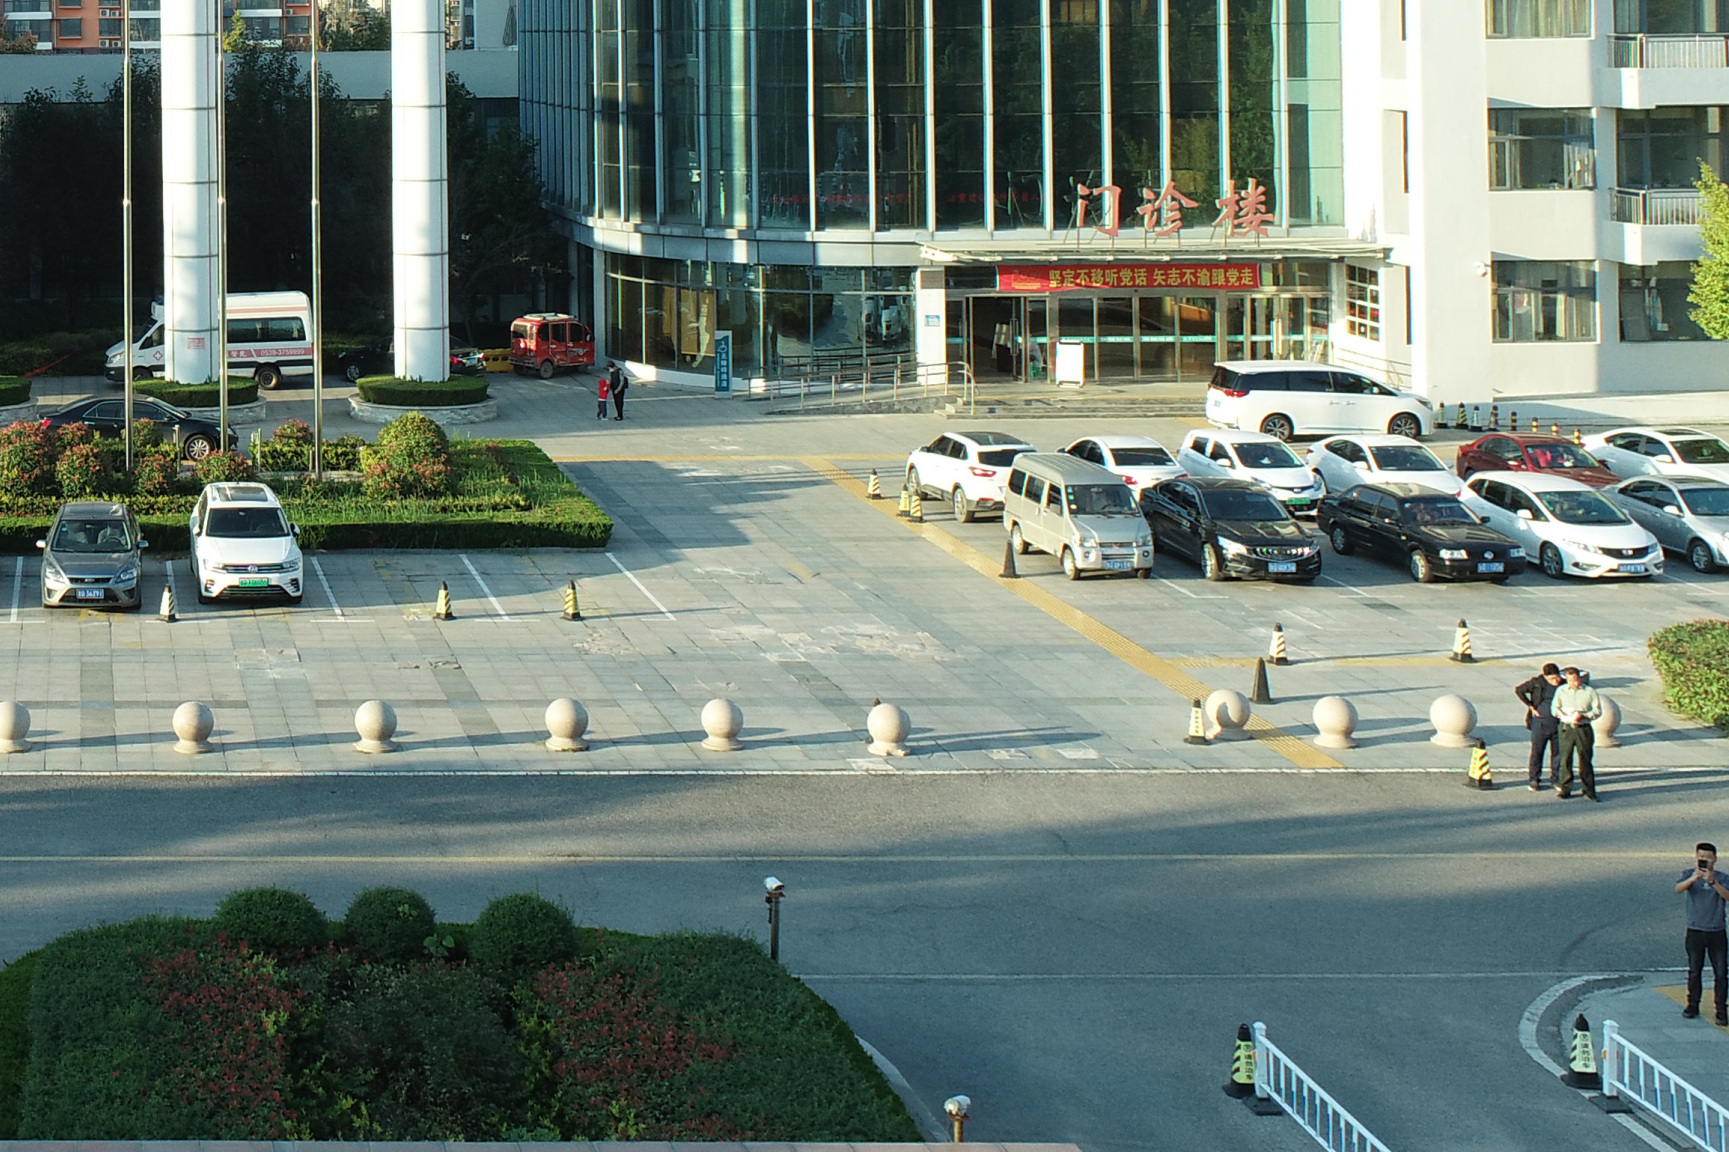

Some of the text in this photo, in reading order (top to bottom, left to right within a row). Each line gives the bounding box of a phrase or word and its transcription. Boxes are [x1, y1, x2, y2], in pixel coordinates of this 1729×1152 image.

[1077, 177, 1275, 237] 门诊楼
[1049, 268, 1254, 288] 坚定不移听党话 矢志不渝跟党走
